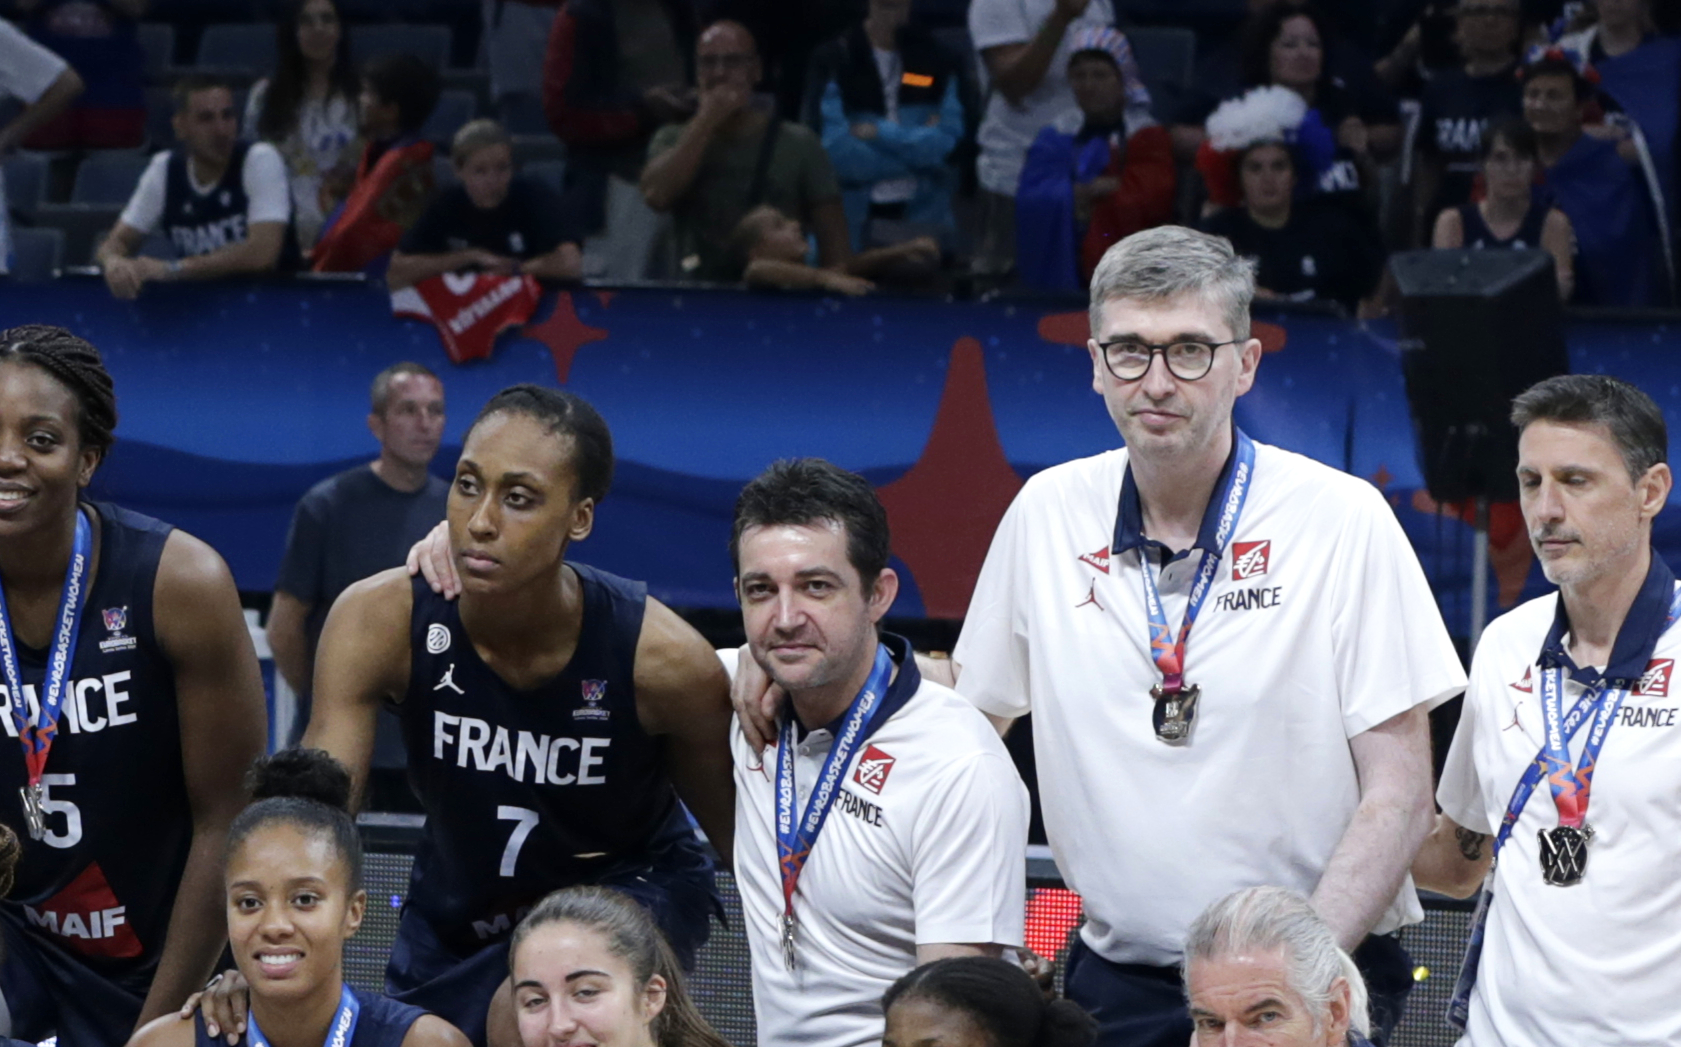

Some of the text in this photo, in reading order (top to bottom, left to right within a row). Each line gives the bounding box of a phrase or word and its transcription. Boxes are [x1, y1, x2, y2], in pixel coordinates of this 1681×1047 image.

[47, 554, 84, 706] #EUROBASKETWOMEN
[1214, 587, 1282, 613] FRANCE
[434, 710, 611, 785] FRANCE
[806, 690, 876, 833] #EUROBASKETWOMEN
[40, 773, 83, 849] 5
[497, 805, 540, 878] 7
[832, 788, 884, 829] FRANCE
[23, 904, 126, 940] MAIF
